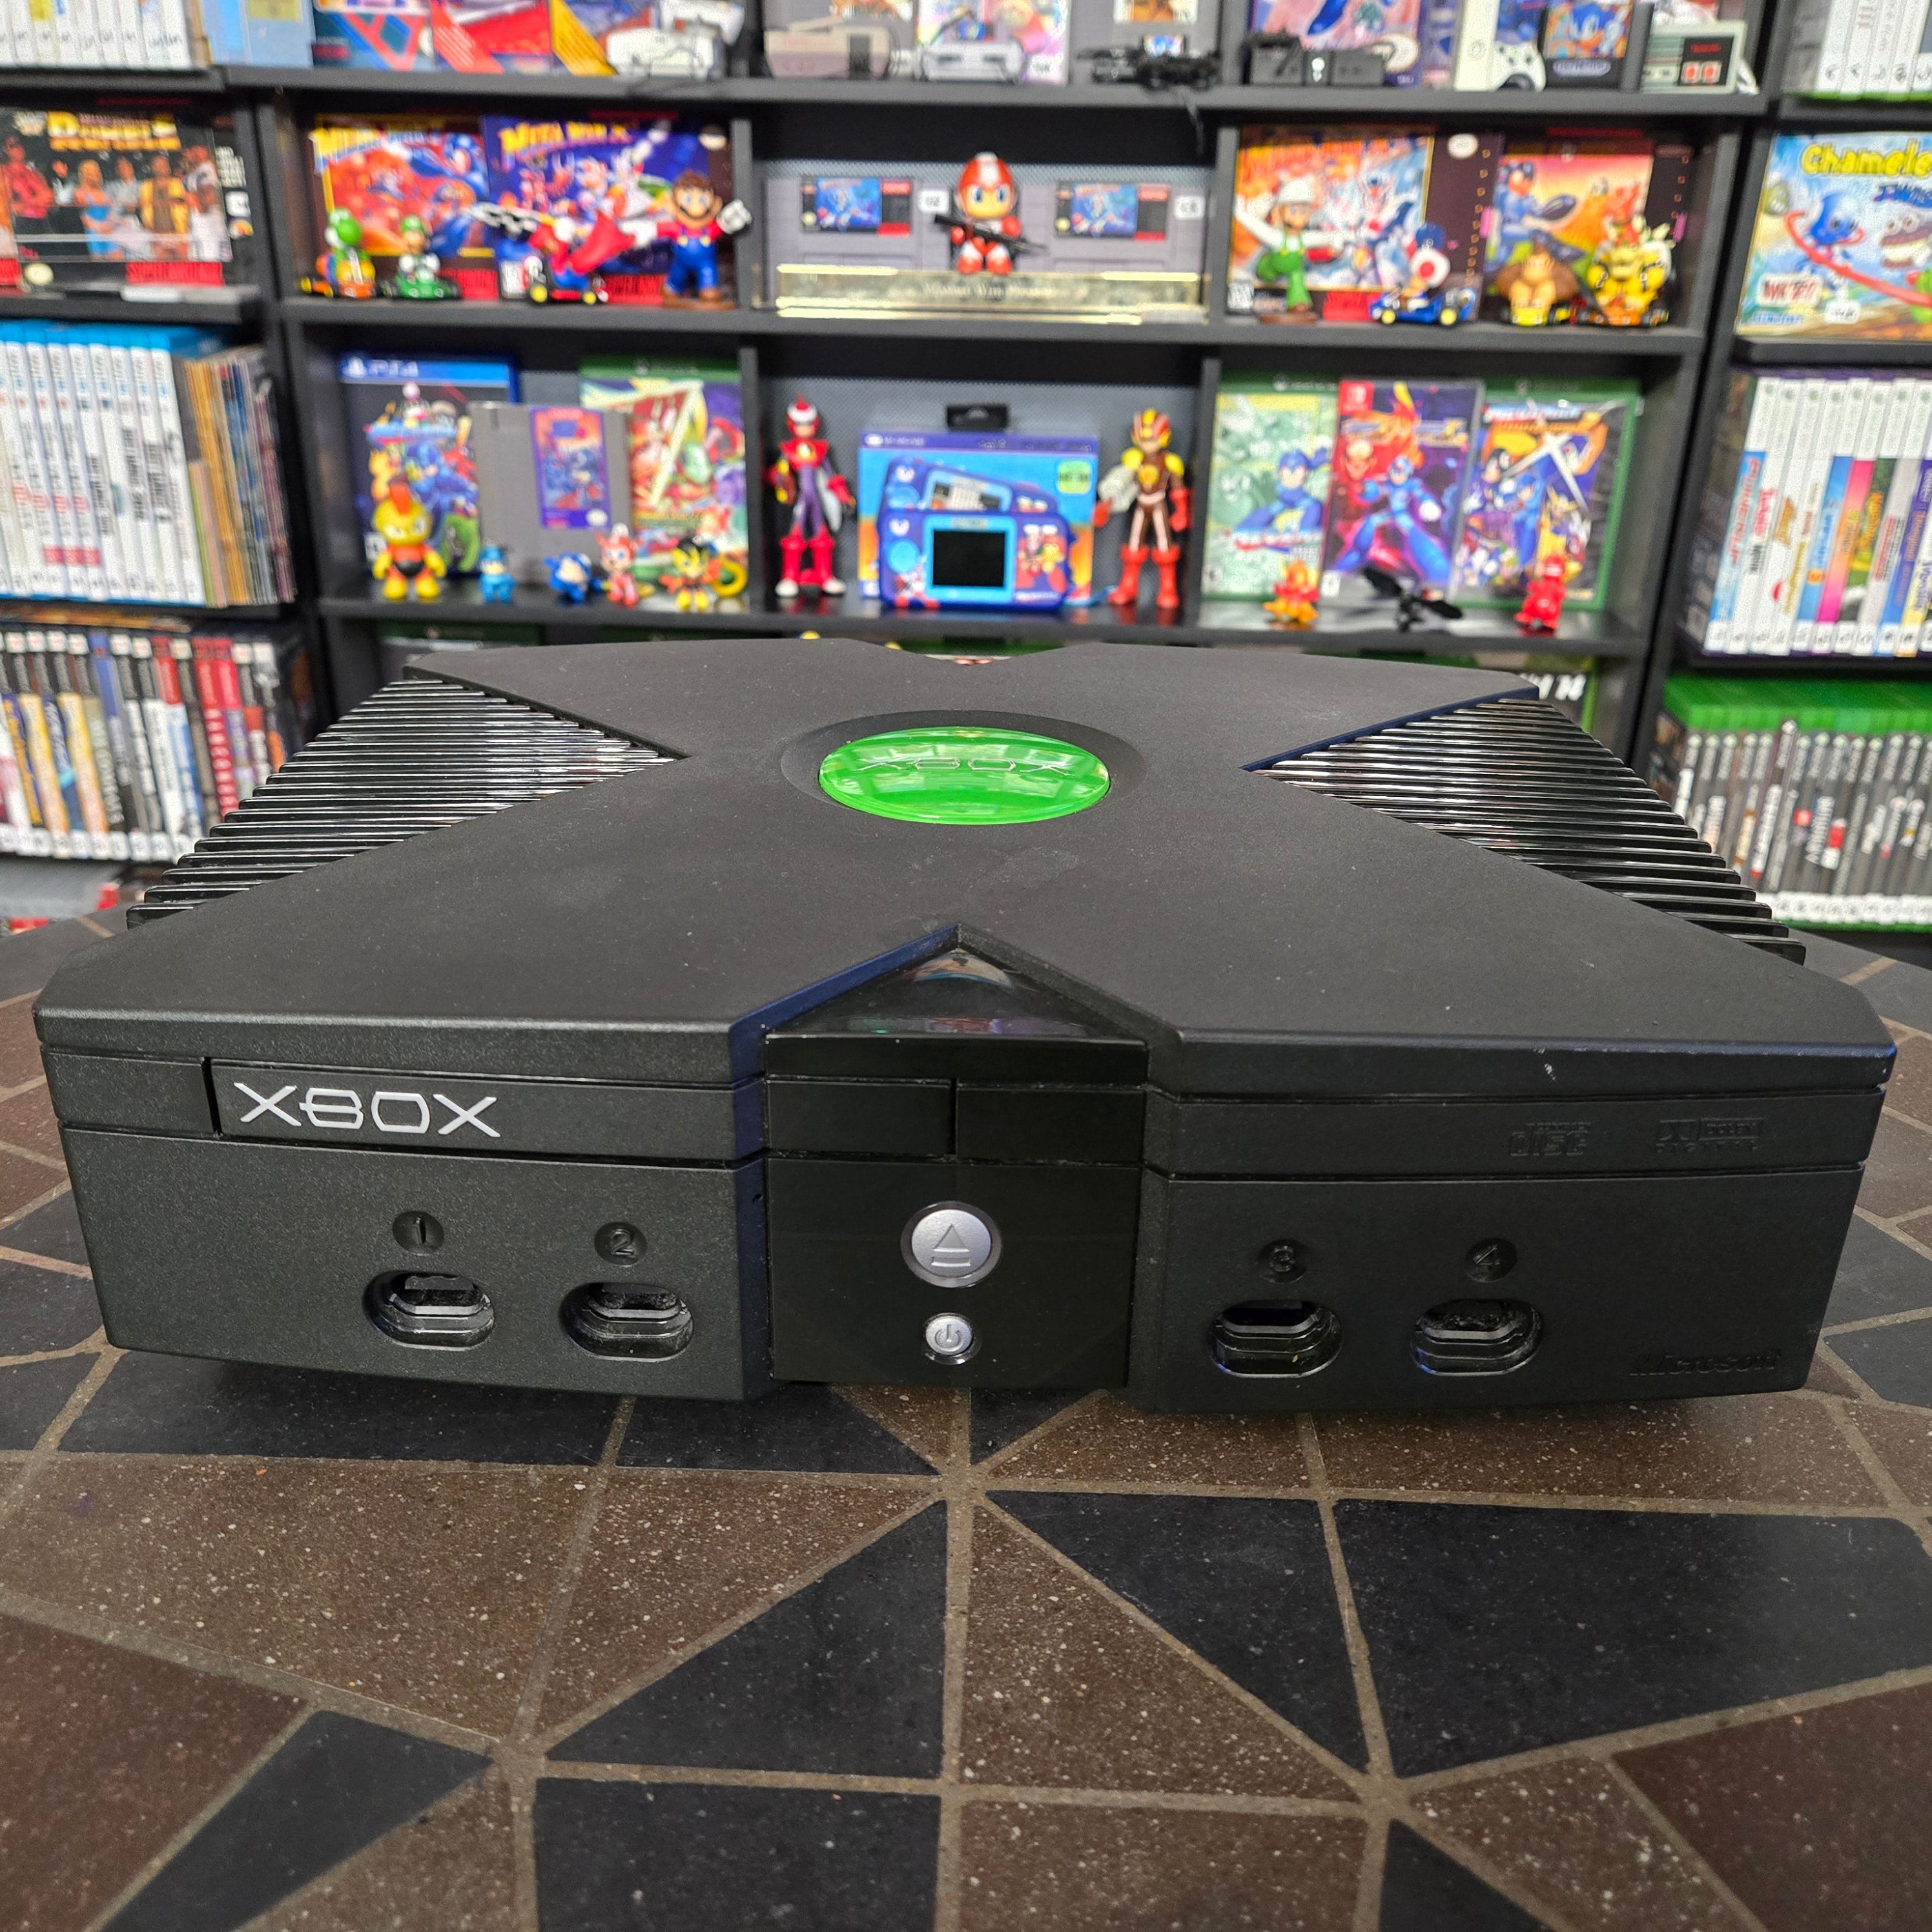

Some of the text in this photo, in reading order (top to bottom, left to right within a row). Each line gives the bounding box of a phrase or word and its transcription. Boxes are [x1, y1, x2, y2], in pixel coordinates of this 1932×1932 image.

[852, 756, 1073, 776] XBOX
[233, 1082, 501, 1138] XBOX
[611, 1228, 635, 1256] 2
